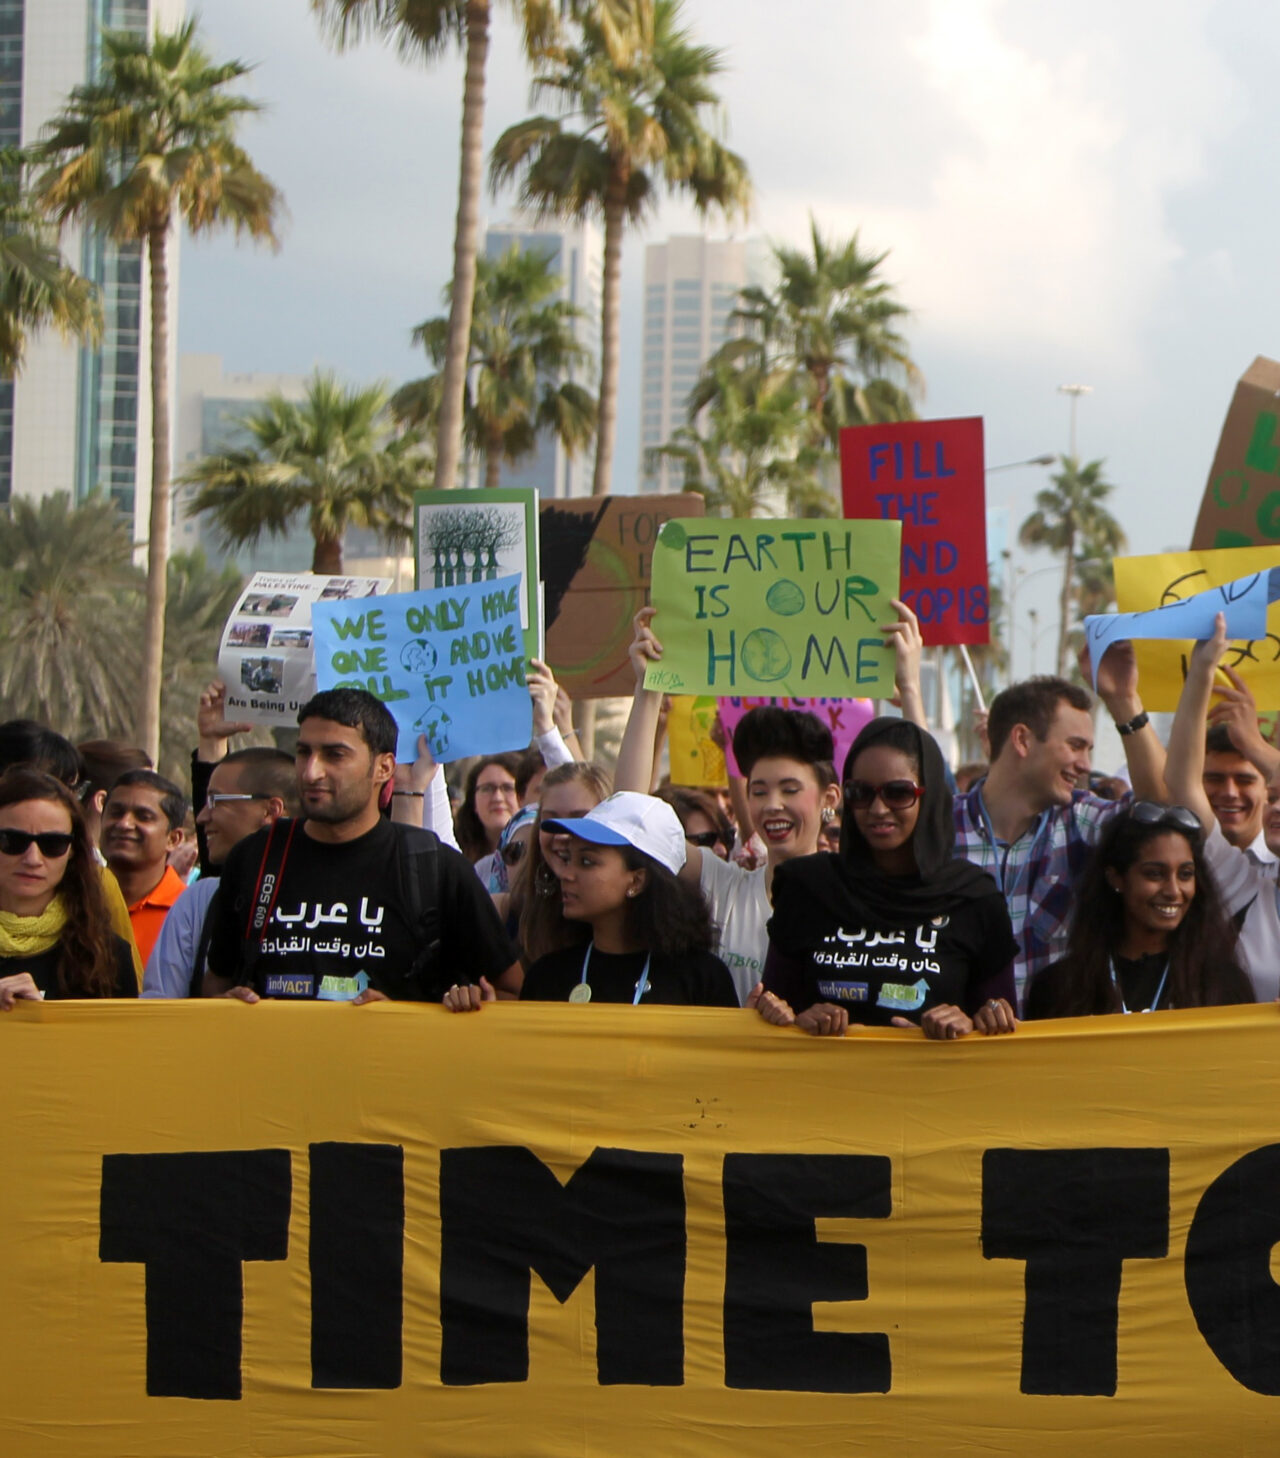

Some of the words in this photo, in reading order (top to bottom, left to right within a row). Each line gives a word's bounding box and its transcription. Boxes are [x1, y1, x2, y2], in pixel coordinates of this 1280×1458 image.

[868, 440, 956, 481] FILL
[875, 492, 940, 526] THE
[686, 531, 852, 573] EARTH
[694, 584, 729, 620] IS
[766, 575, 880, 622] OUR
[331, 608, 388, 641] WE
[406, 597, 470, 634] ONLY
[331, 647, 389, 674] ONE
[451, 631, 490, 665] AND
[707, 627, 886, 686] HOME
[467, 655, 527, 697] HOME
[228, 696, 247, 708] Are
[251, 698, 285, 712] Being
[260, 874, 275, 904] EOS
[360, 897, 384, 933] يا
[314, 938, 350, 957] وقت
[354, 941, 385, 958] حان
[872, 953, 907, 971] وقت
[911, 958, 940, 973] حان
[268, 976, 312, 994] indyACT
[820, 981, 866, 1000] indyACT
[98, 1141, 893, 1400] TIME
